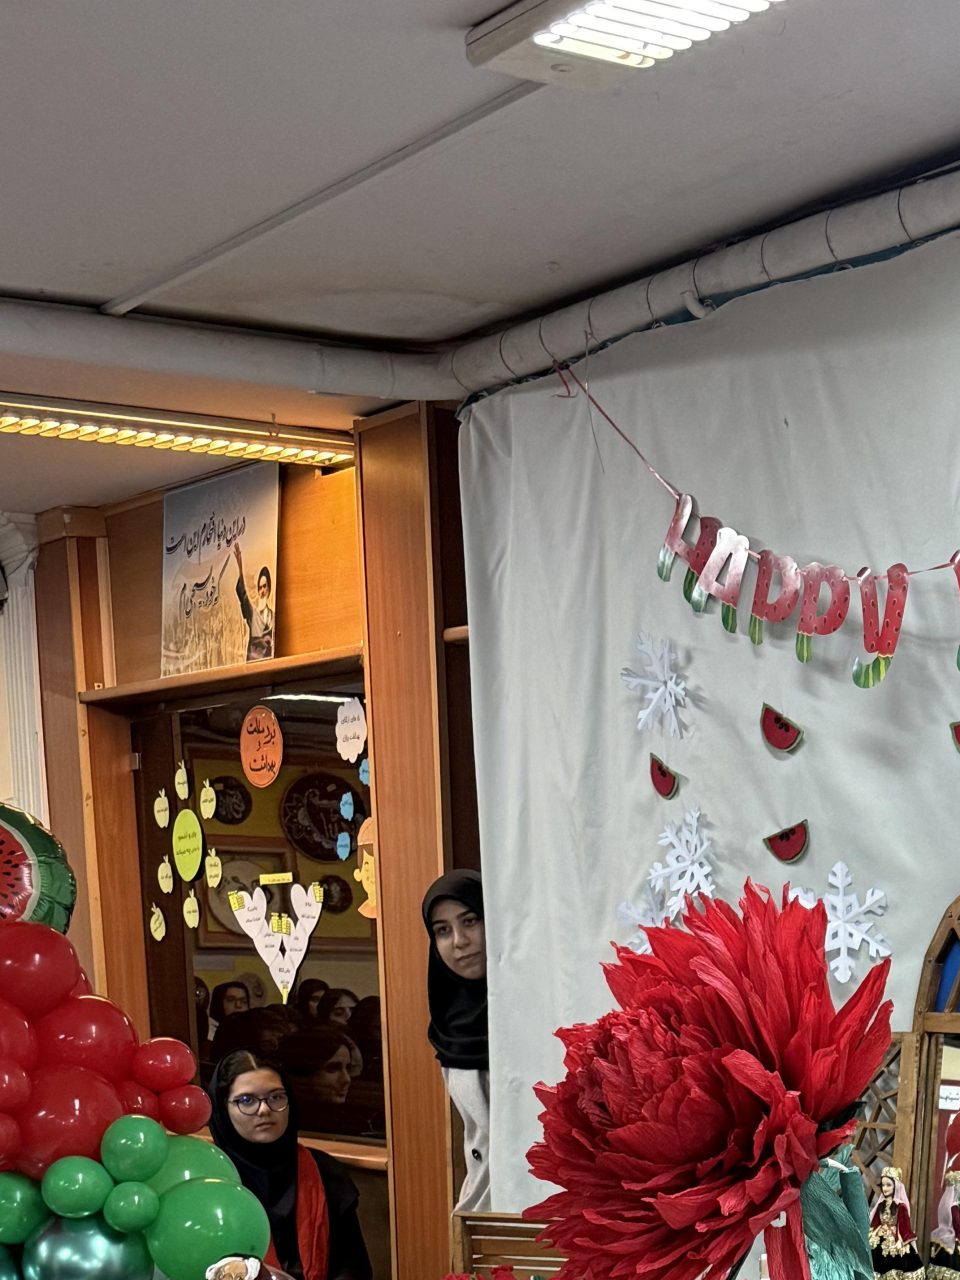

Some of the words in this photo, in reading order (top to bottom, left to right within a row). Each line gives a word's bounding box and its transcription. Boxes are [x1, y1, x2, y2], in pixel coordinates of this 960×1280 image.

[165, 532, 187, 555] است
[657, 493, 910, 690] HAPPY
[249, 754, 276, 776] بهداشت
